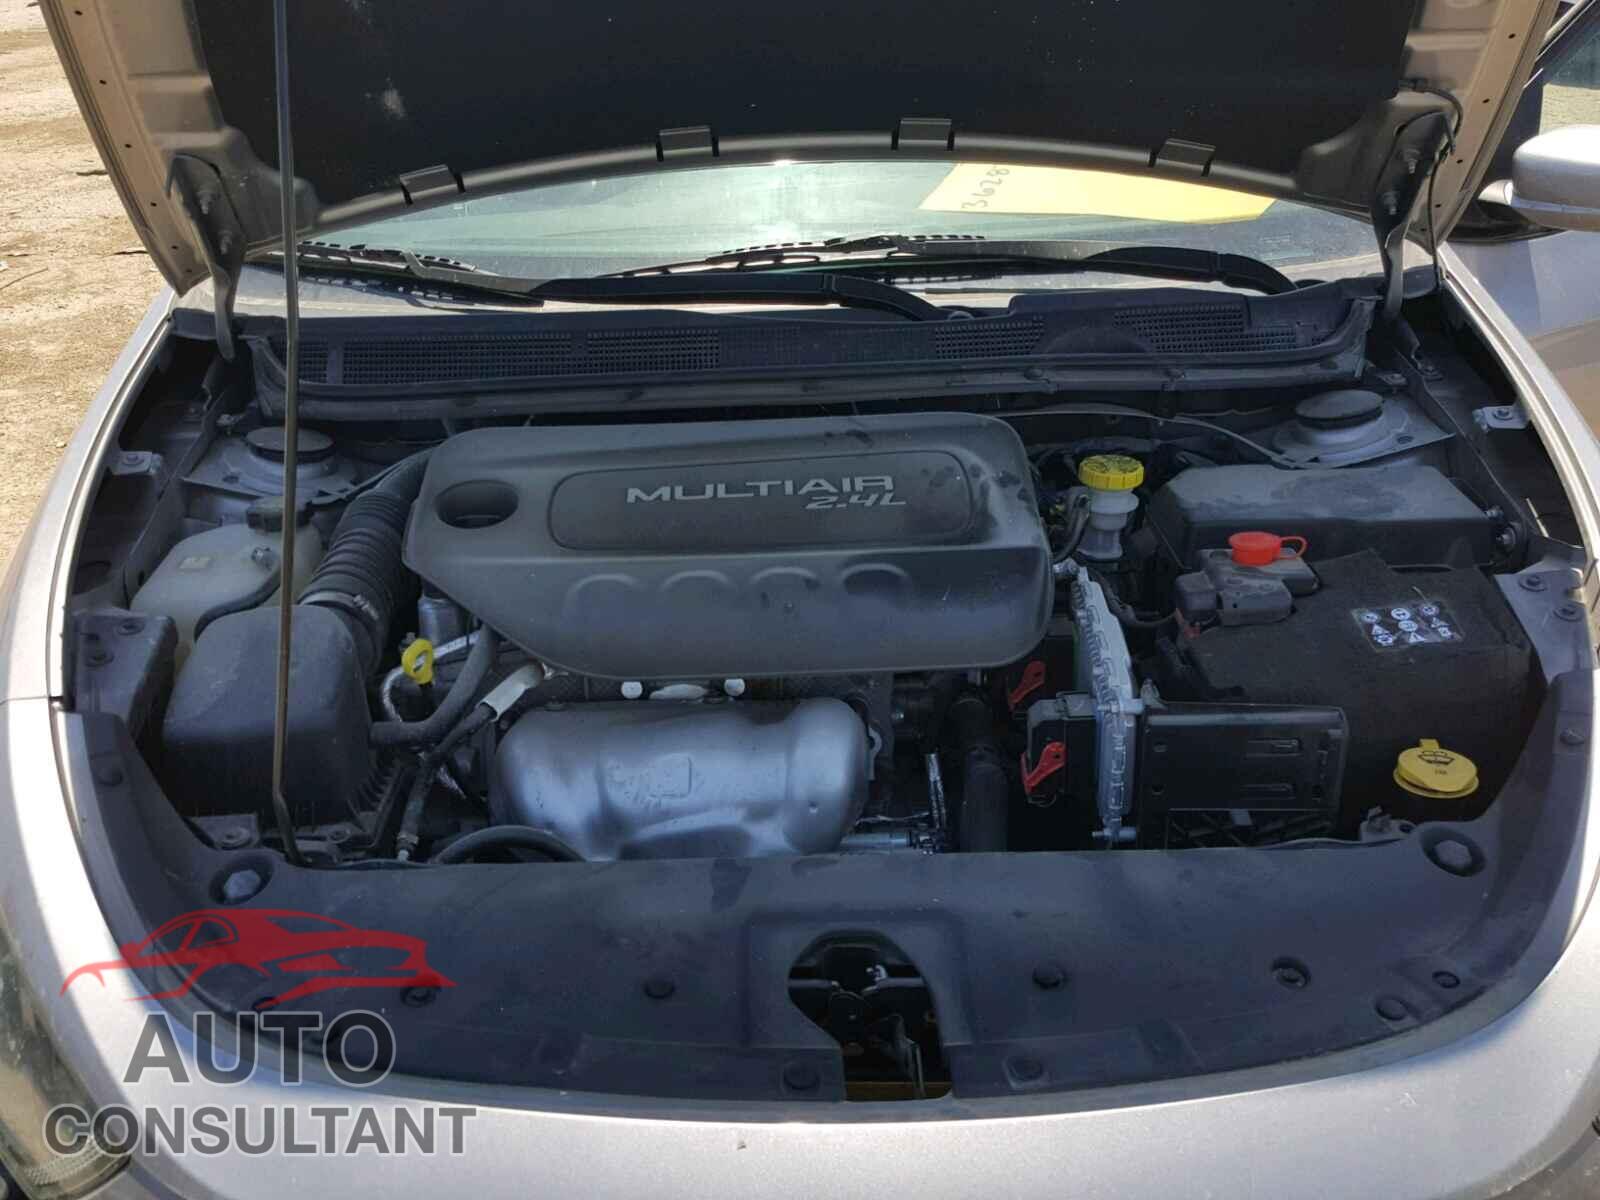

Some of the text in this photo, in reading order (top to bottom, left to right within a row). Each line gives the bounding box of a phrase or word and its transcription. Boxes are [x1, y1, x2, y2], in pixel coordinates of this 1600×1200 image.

[961, 164, 1010, 209] 3628
[626, 476, 894, 503] MULTIAIR
[805, 492, 907, 509] 2.4L
